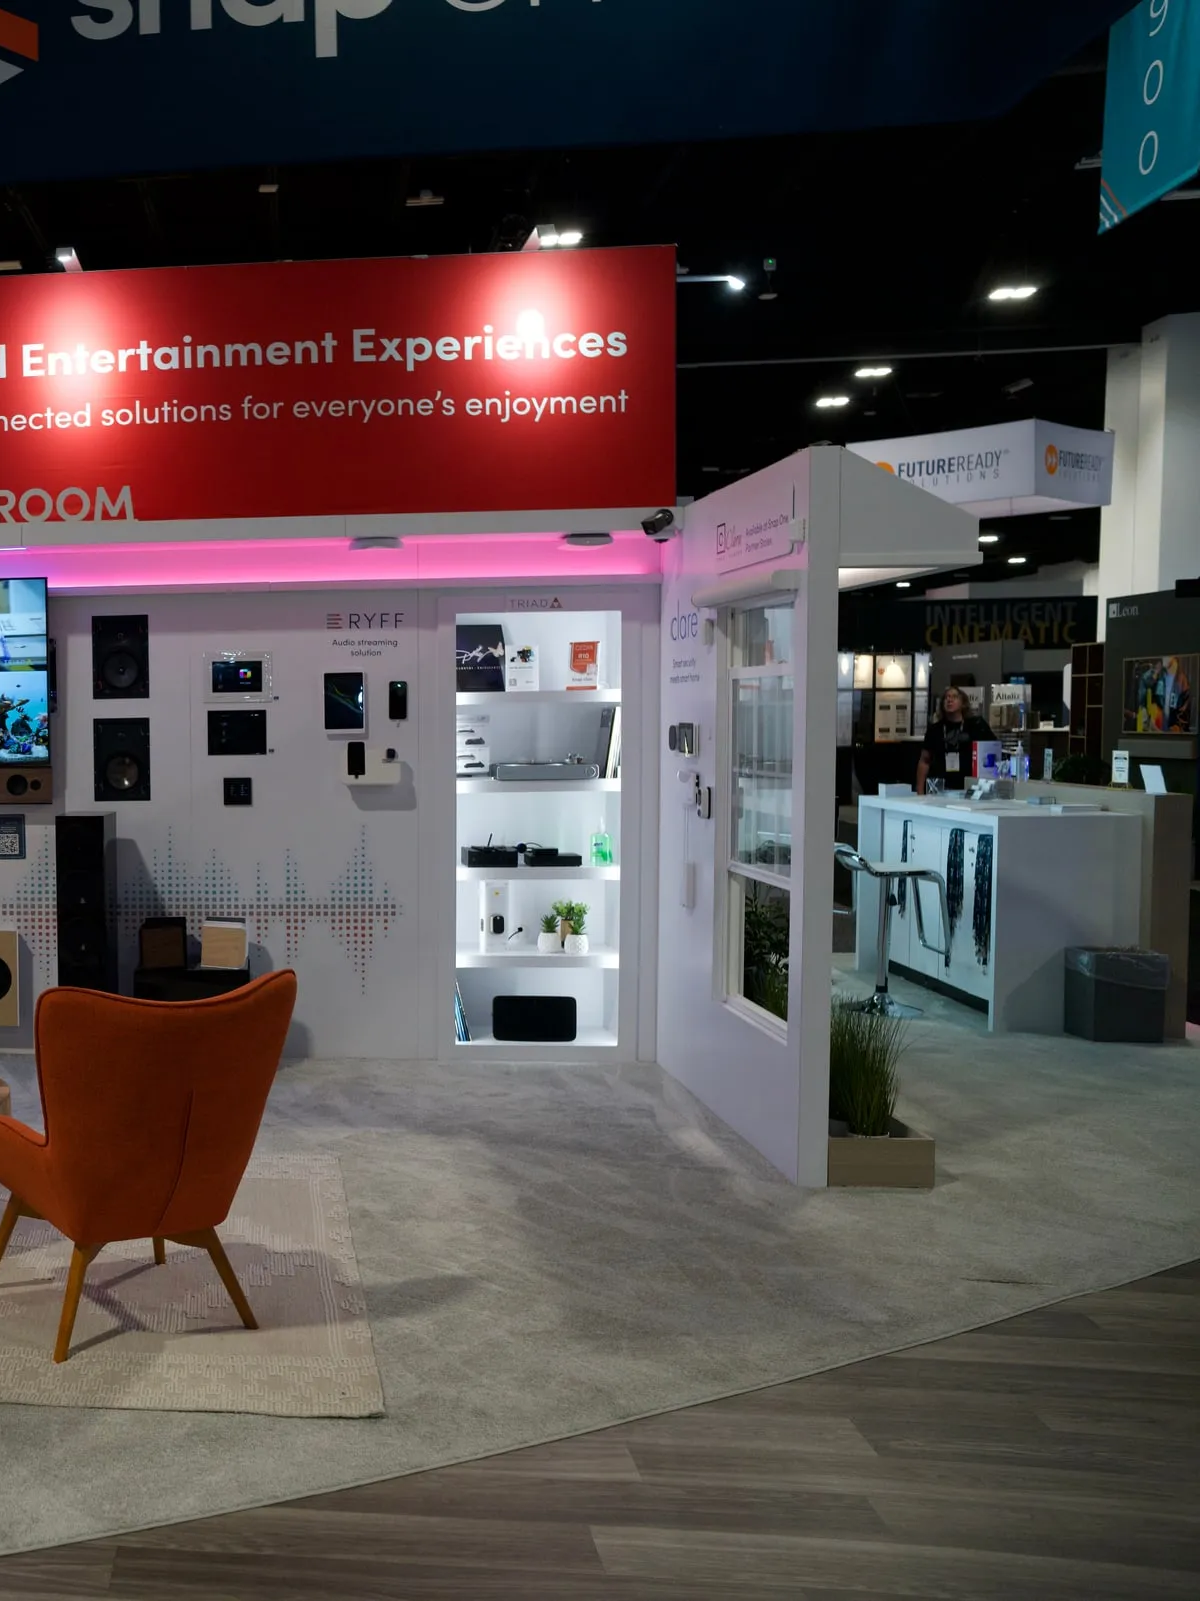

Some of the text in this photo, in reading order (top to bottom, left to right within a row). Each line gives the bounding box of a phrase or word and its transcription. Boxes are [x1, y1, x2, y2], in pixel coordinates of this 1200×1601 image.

[22, 332, 338, 378] Entertainment
[353, 325, 628, 372] Experiences
[101, 398, 232, 427] solutions
[241, 395, 284, 420] for
[292, 390, 455, 424] everyone’s
[465, 389, 629, 424] enjoyment
[898, 449, 1002, 478] FUTUREREADY
[910, 468, 1000, 487] OLUTIONS
[509, 599, 548, 609] TRIAD
[925, 601, 1078, 625] INTELLIGENT
[1117, 602, 1139, 617] Leon
[349, 612, 405, 629] RYFF
[332, 638, 398, 648] Audio streaming
[925, 619, 1077, 648] CINEMATIC
[351, 649, 382, 657] solution
